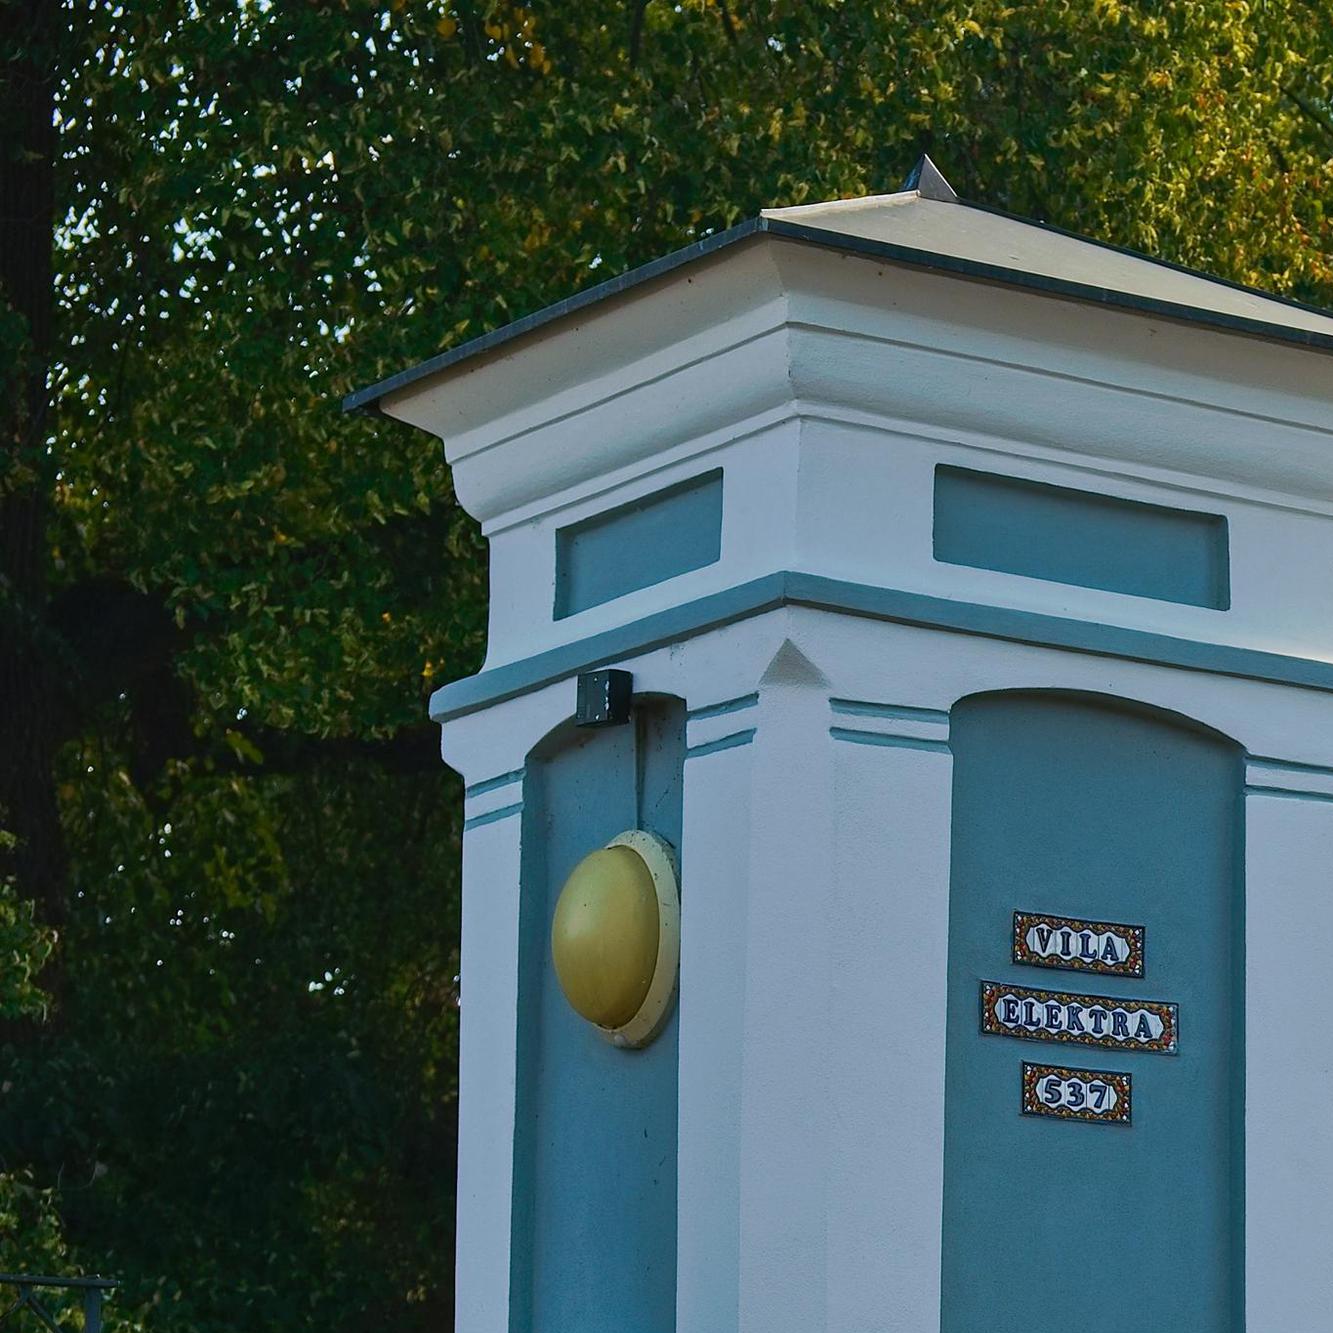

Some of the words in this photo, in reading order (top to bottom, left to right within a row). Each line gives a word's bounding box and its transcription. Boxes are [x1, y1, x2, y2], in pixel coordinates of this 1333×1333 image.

[1036, 927, 1120, 962] VILA
[1002, 998, 1153, 1039] ELEKTRA
[1043, 1078, 1108, 1109] 537
